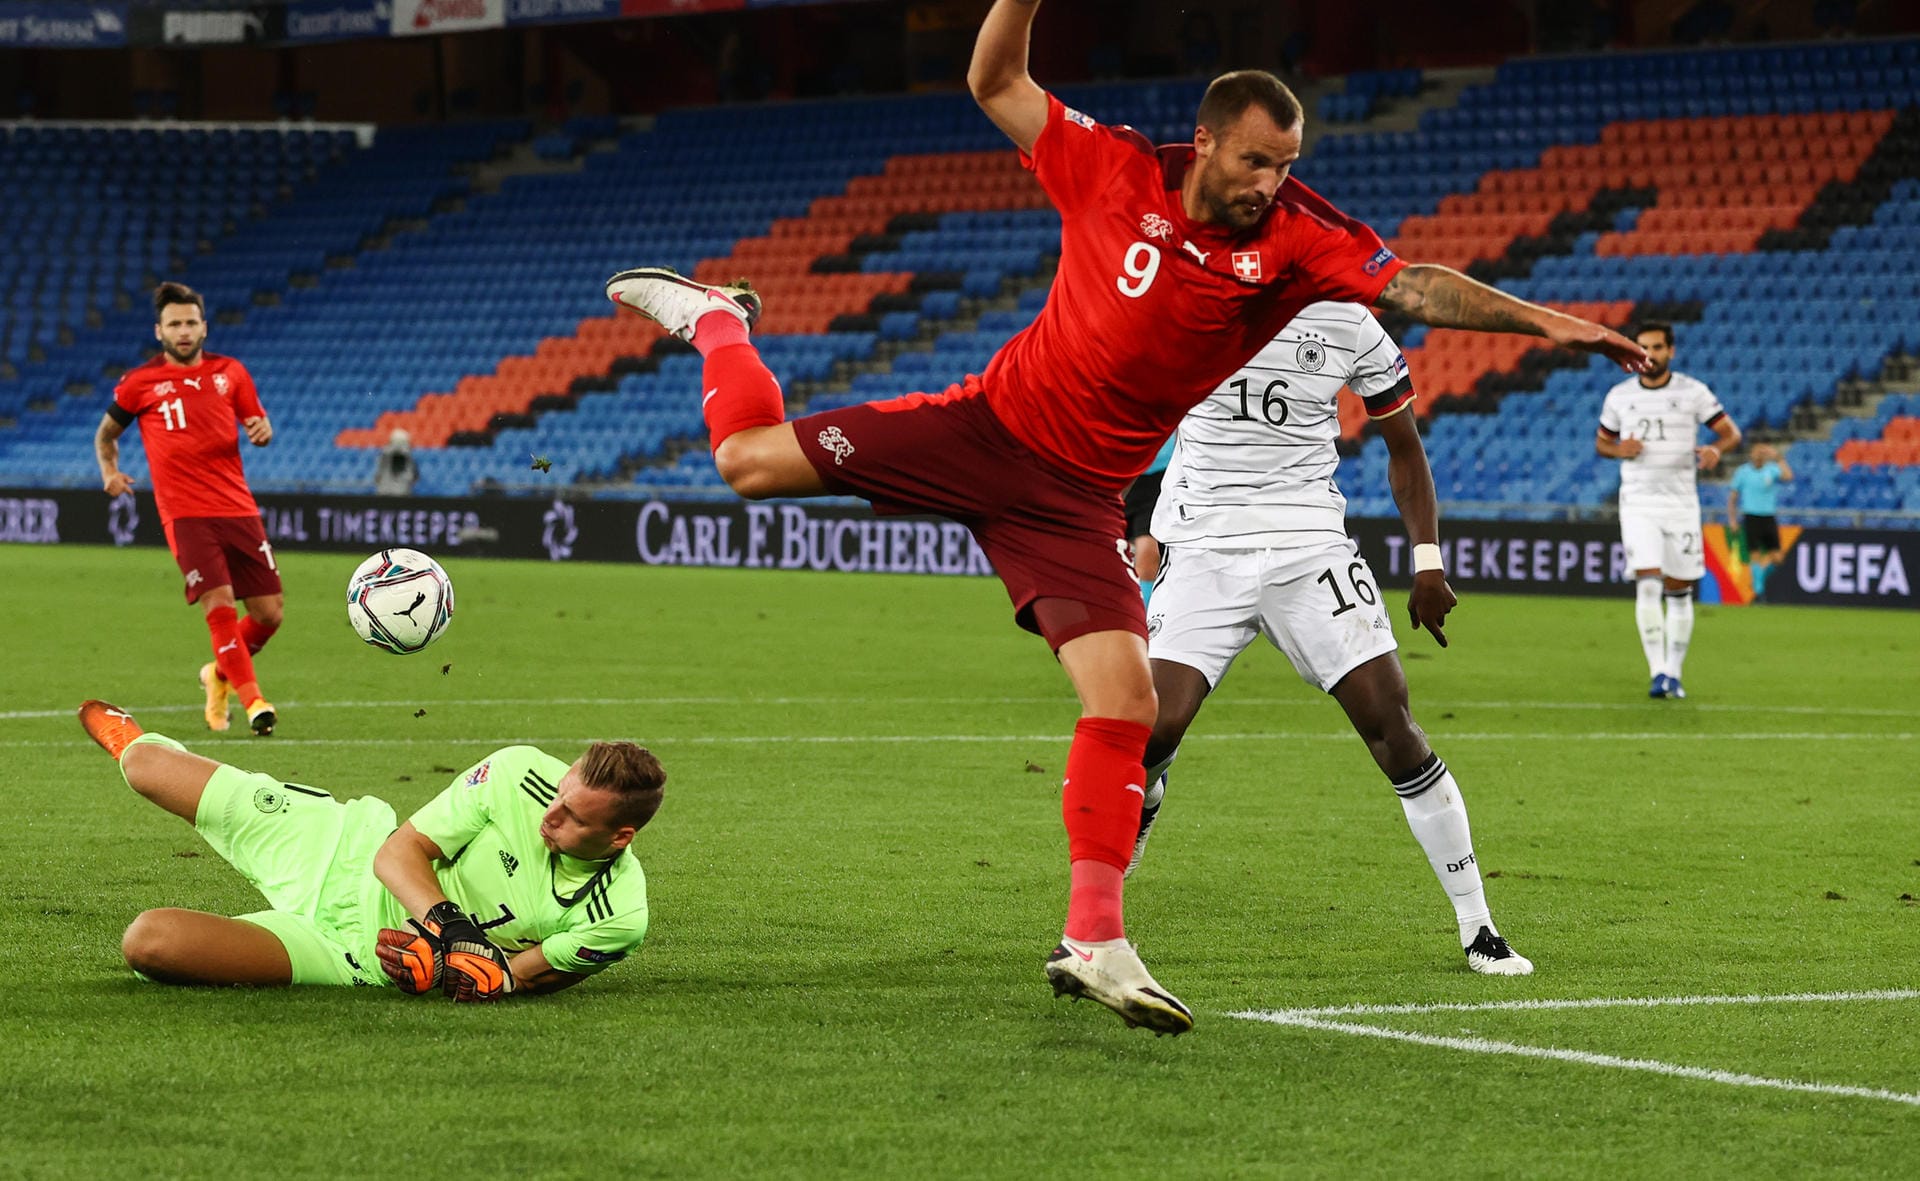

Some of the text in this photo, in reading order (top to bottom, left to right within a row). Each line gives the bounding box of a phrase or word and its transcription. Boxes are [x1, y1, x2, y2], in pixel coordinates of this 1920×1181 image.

[163, 11, 245, 42] PUMA
[1116, 241, 1161, 298] 9
[157, 398, 187, 431] 11
[1229, 378, 1290, 426] 16
[1637, 418, 1667, 441] 21
[259, 506, 309, 541] IAL
[636, 501, 741, 566] CARL
[744, 504, 774, 568] F.
[258, 540, 280, 576] 1
[1796, 541, 1910, 596] UEFA
[1317, 561, 1375, 617] 16
